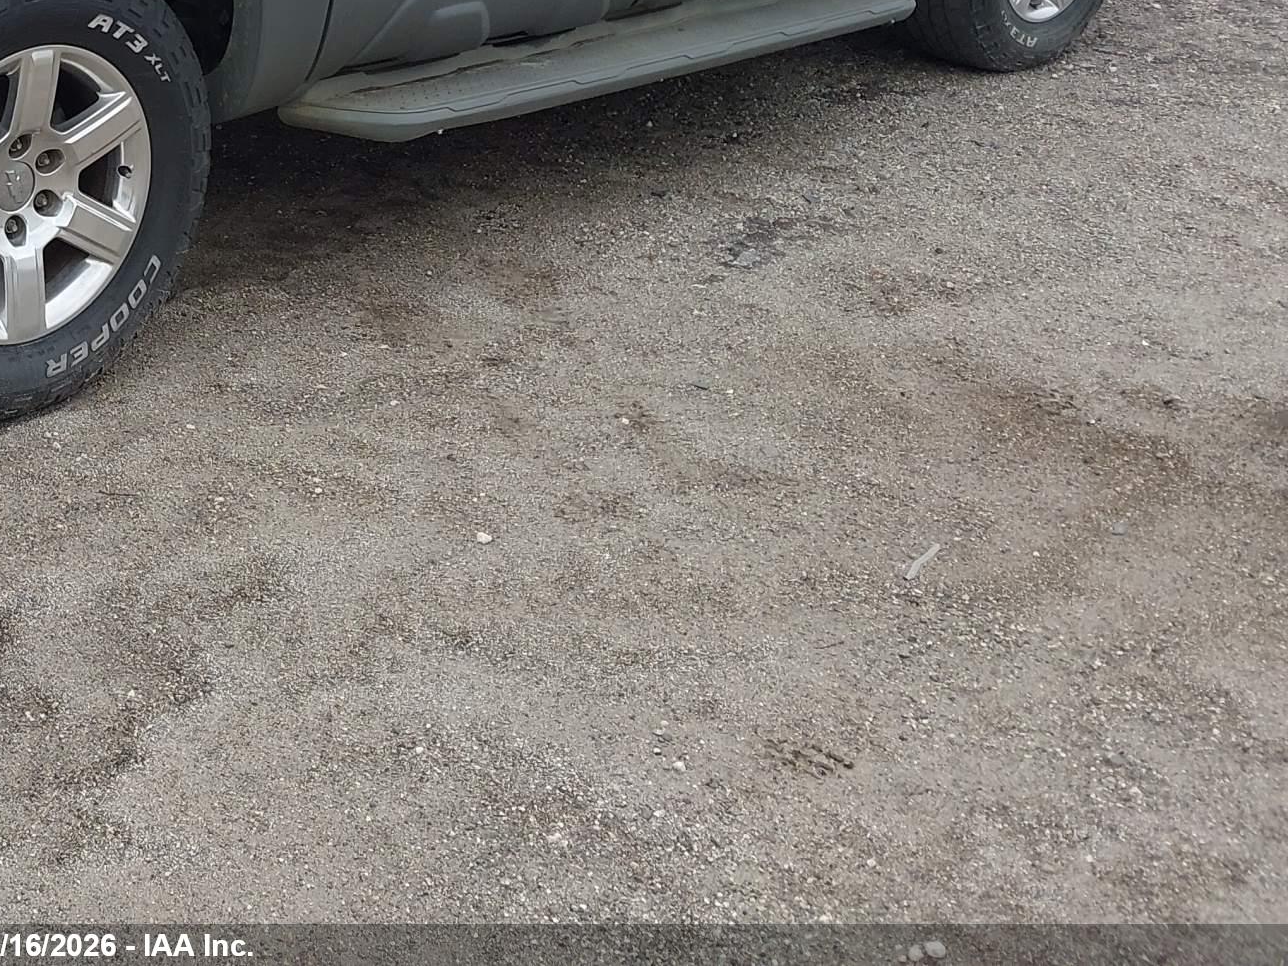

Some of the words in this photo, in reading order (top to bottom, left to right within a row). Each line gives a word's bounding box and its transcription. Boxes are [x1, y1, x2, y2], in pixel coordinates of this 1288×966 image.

[87, 14, 149, 54] AT3
[143, 53, 171, 83] XLT
[45, 254, 162, 378] COOPER
